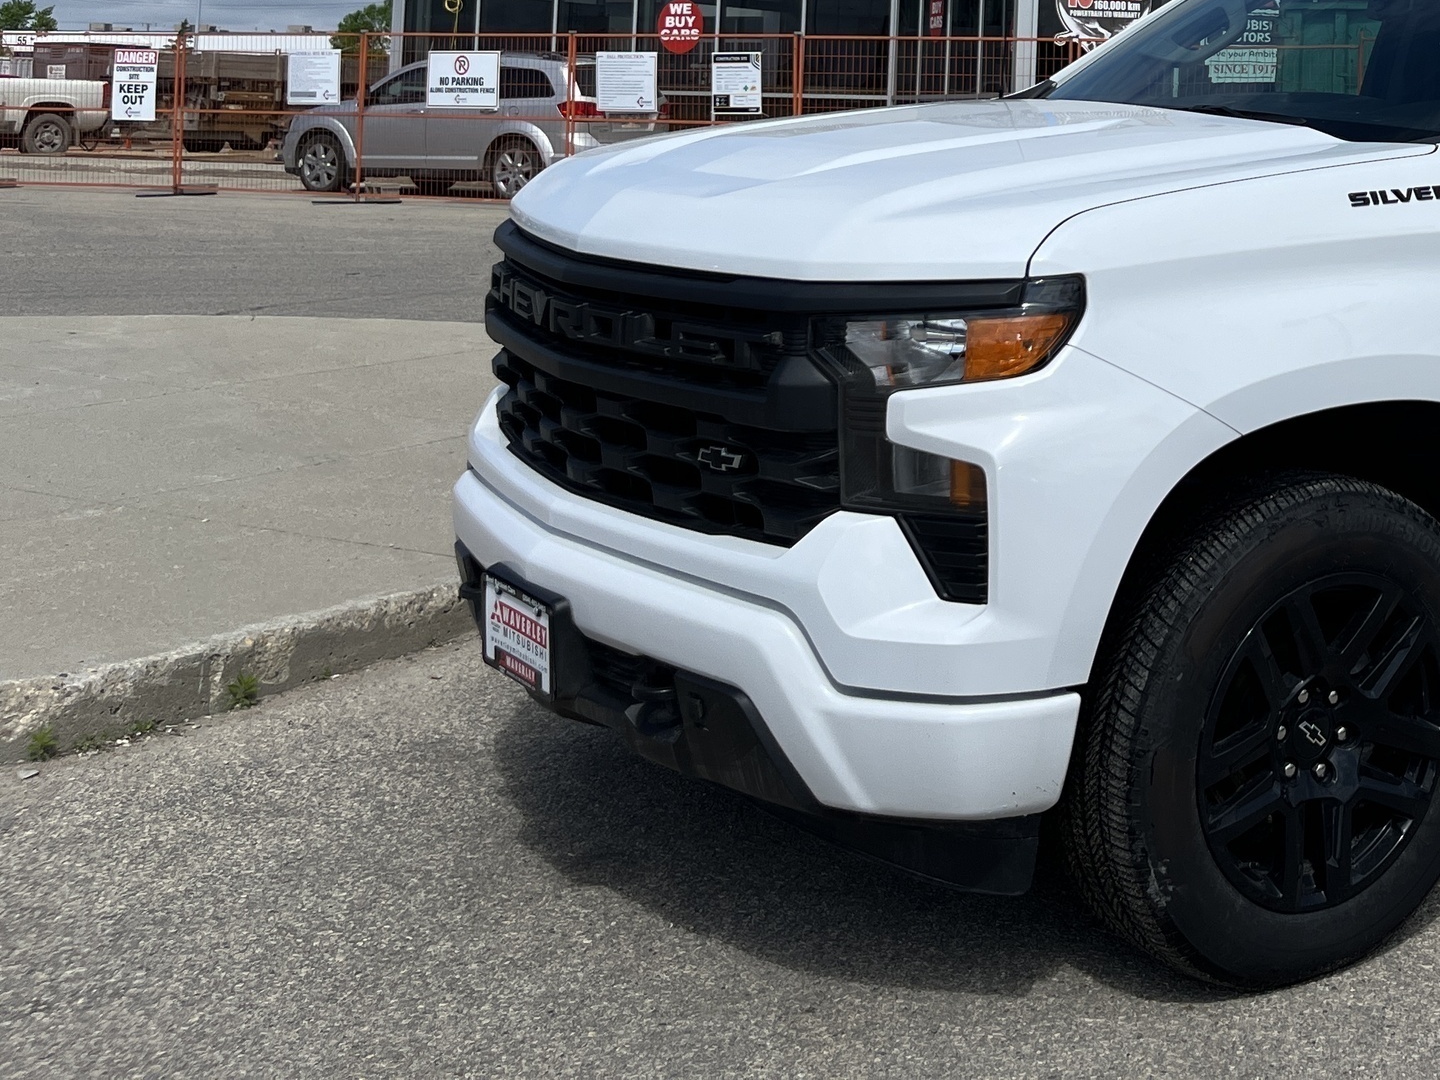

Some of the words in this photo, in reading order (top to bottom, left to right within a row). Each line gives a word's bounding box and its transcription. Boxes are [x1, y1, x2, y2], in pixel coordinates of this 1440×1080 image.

[669, 3, 692, 15] WE
[1127, 1, 1140, 11] km
[665, 16, 696, 28] BUY
[660, 29, 700, 40] CARS
[116, 51, 156, 64] DANGER
[1213, 64, 1248, 74] SINCE
[1252, 64, 1277, 74] 1917
[439, 76, 450, 86] NO
[451, 76, 485, 87] PARKING
[119, 83, 149, 94] KEEP
[122, 95, 145, 105] OUT
[502, 605, 546, 646] WAVERLEY
[503, 626, 547, 662] MITSUBISHI
[505, 655, 536, 682] WAVERLEY
